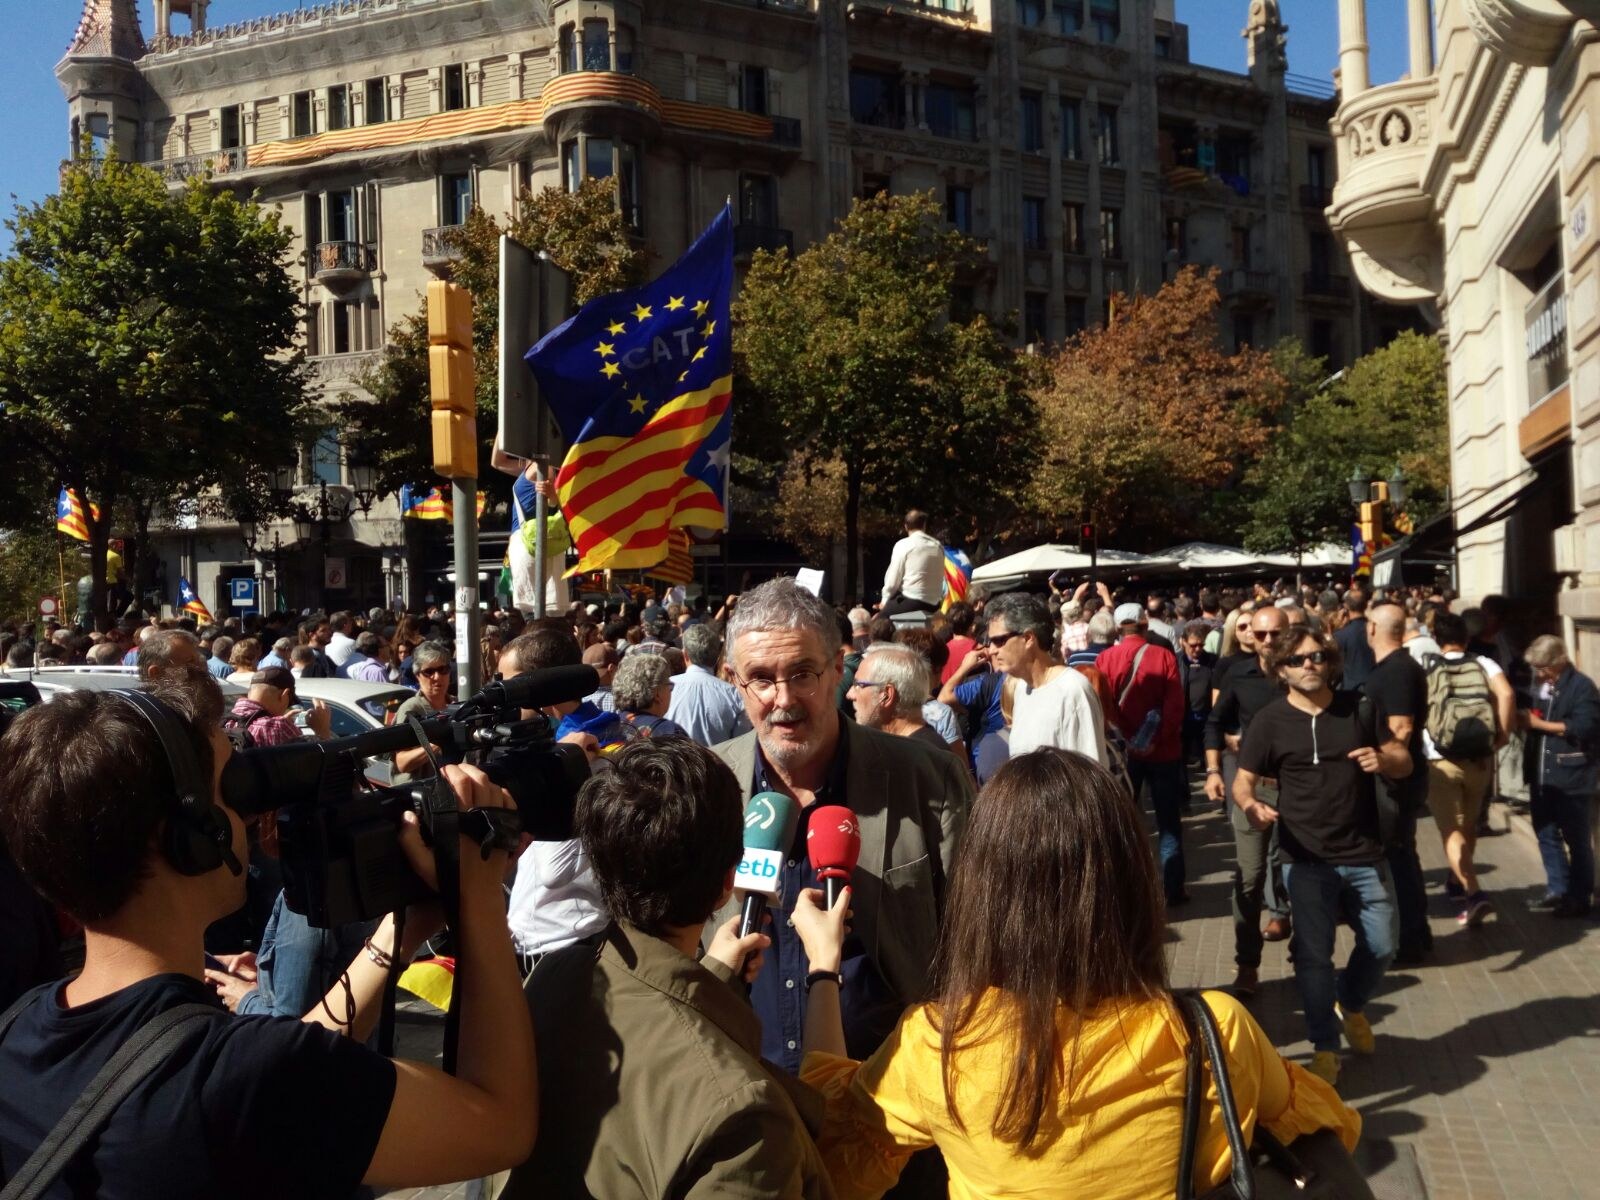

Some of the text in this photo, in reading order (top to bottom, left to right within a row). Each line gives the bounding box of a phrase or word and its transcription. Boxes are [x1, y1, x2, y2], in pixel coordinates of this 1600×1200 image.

[622, 327, 694, 369] CAT
[236, 581, 249, 597] P
[736, 857, 776, 878] etb
